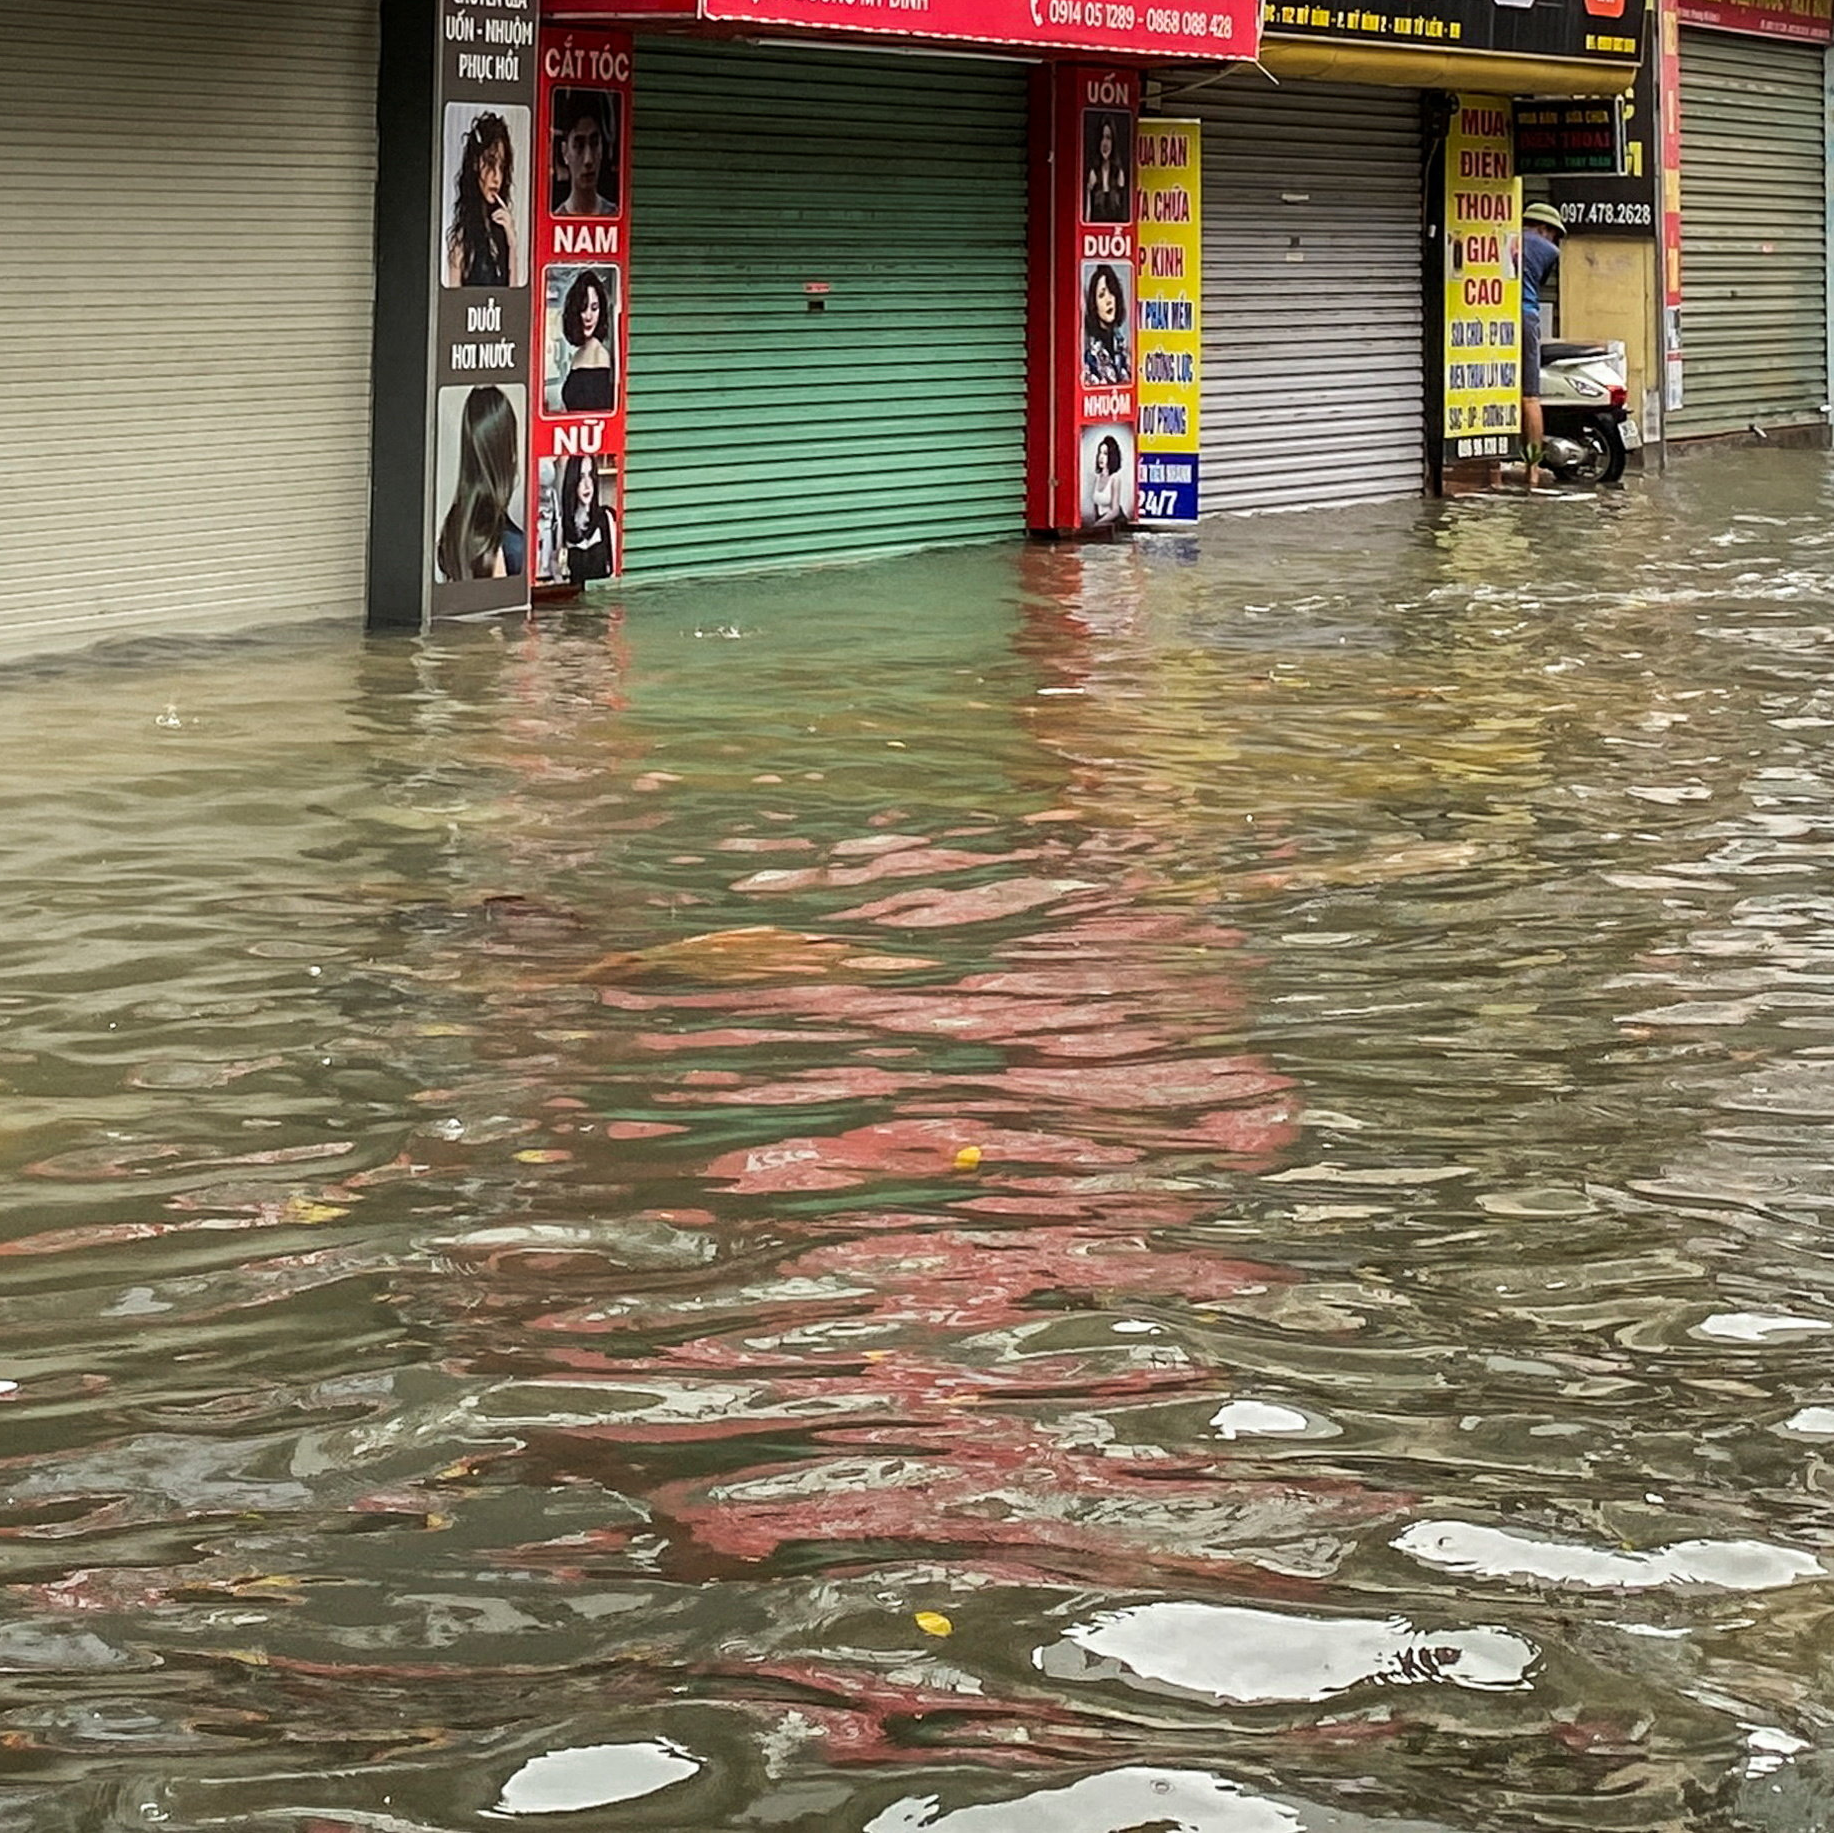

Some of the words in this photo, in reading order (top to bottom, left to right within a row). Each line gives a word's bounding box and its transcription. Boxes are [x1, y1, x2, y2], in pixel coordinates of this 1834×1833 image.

[445, 11, 475, 41] UỐN
[485, 20, 534, 49] NHUỘM
[1049, 0, 1083, 26] 0914
[1084, 2, 1104, 28] 05
[1105, 3, 1135, 31] 1289
[1208, 12, 1234, 39] 428
[458, 51, 493, 83] PHỤC
[494, 47, 520, 82] HỒI
[544, 33, 586, 82] CẮT
[590, 41, 630, 81] TÓC
[1087, 76, 1129, 105] UỐN
[1461, 109, 1505, 136] MUA
[1159, 133, 1189, 167] BÁN
[1460, 146, 1507, 185] ĐIỆN
[1454, 193, 1513, 228] THOẠI
[1560, 203, 1652, 225] 097.478.2628
[554, 226, 618, 255] NAM
[1084, 225, 1132, 259] DUỖI
[1467, 226, 1500, 263] GIÁ
[1150, 243, 1184, 278] KÍNH
[1464, 278, 1504, 306] CAO
[467, 296, 502, 332] DUỖI
[451, 341, 479, 371] HƠI
[479, 340, 517, 370] NƯỚC
[1084, 392, 1131, 422] NHUỘM
[554, 418, 607, 456] NỮ
